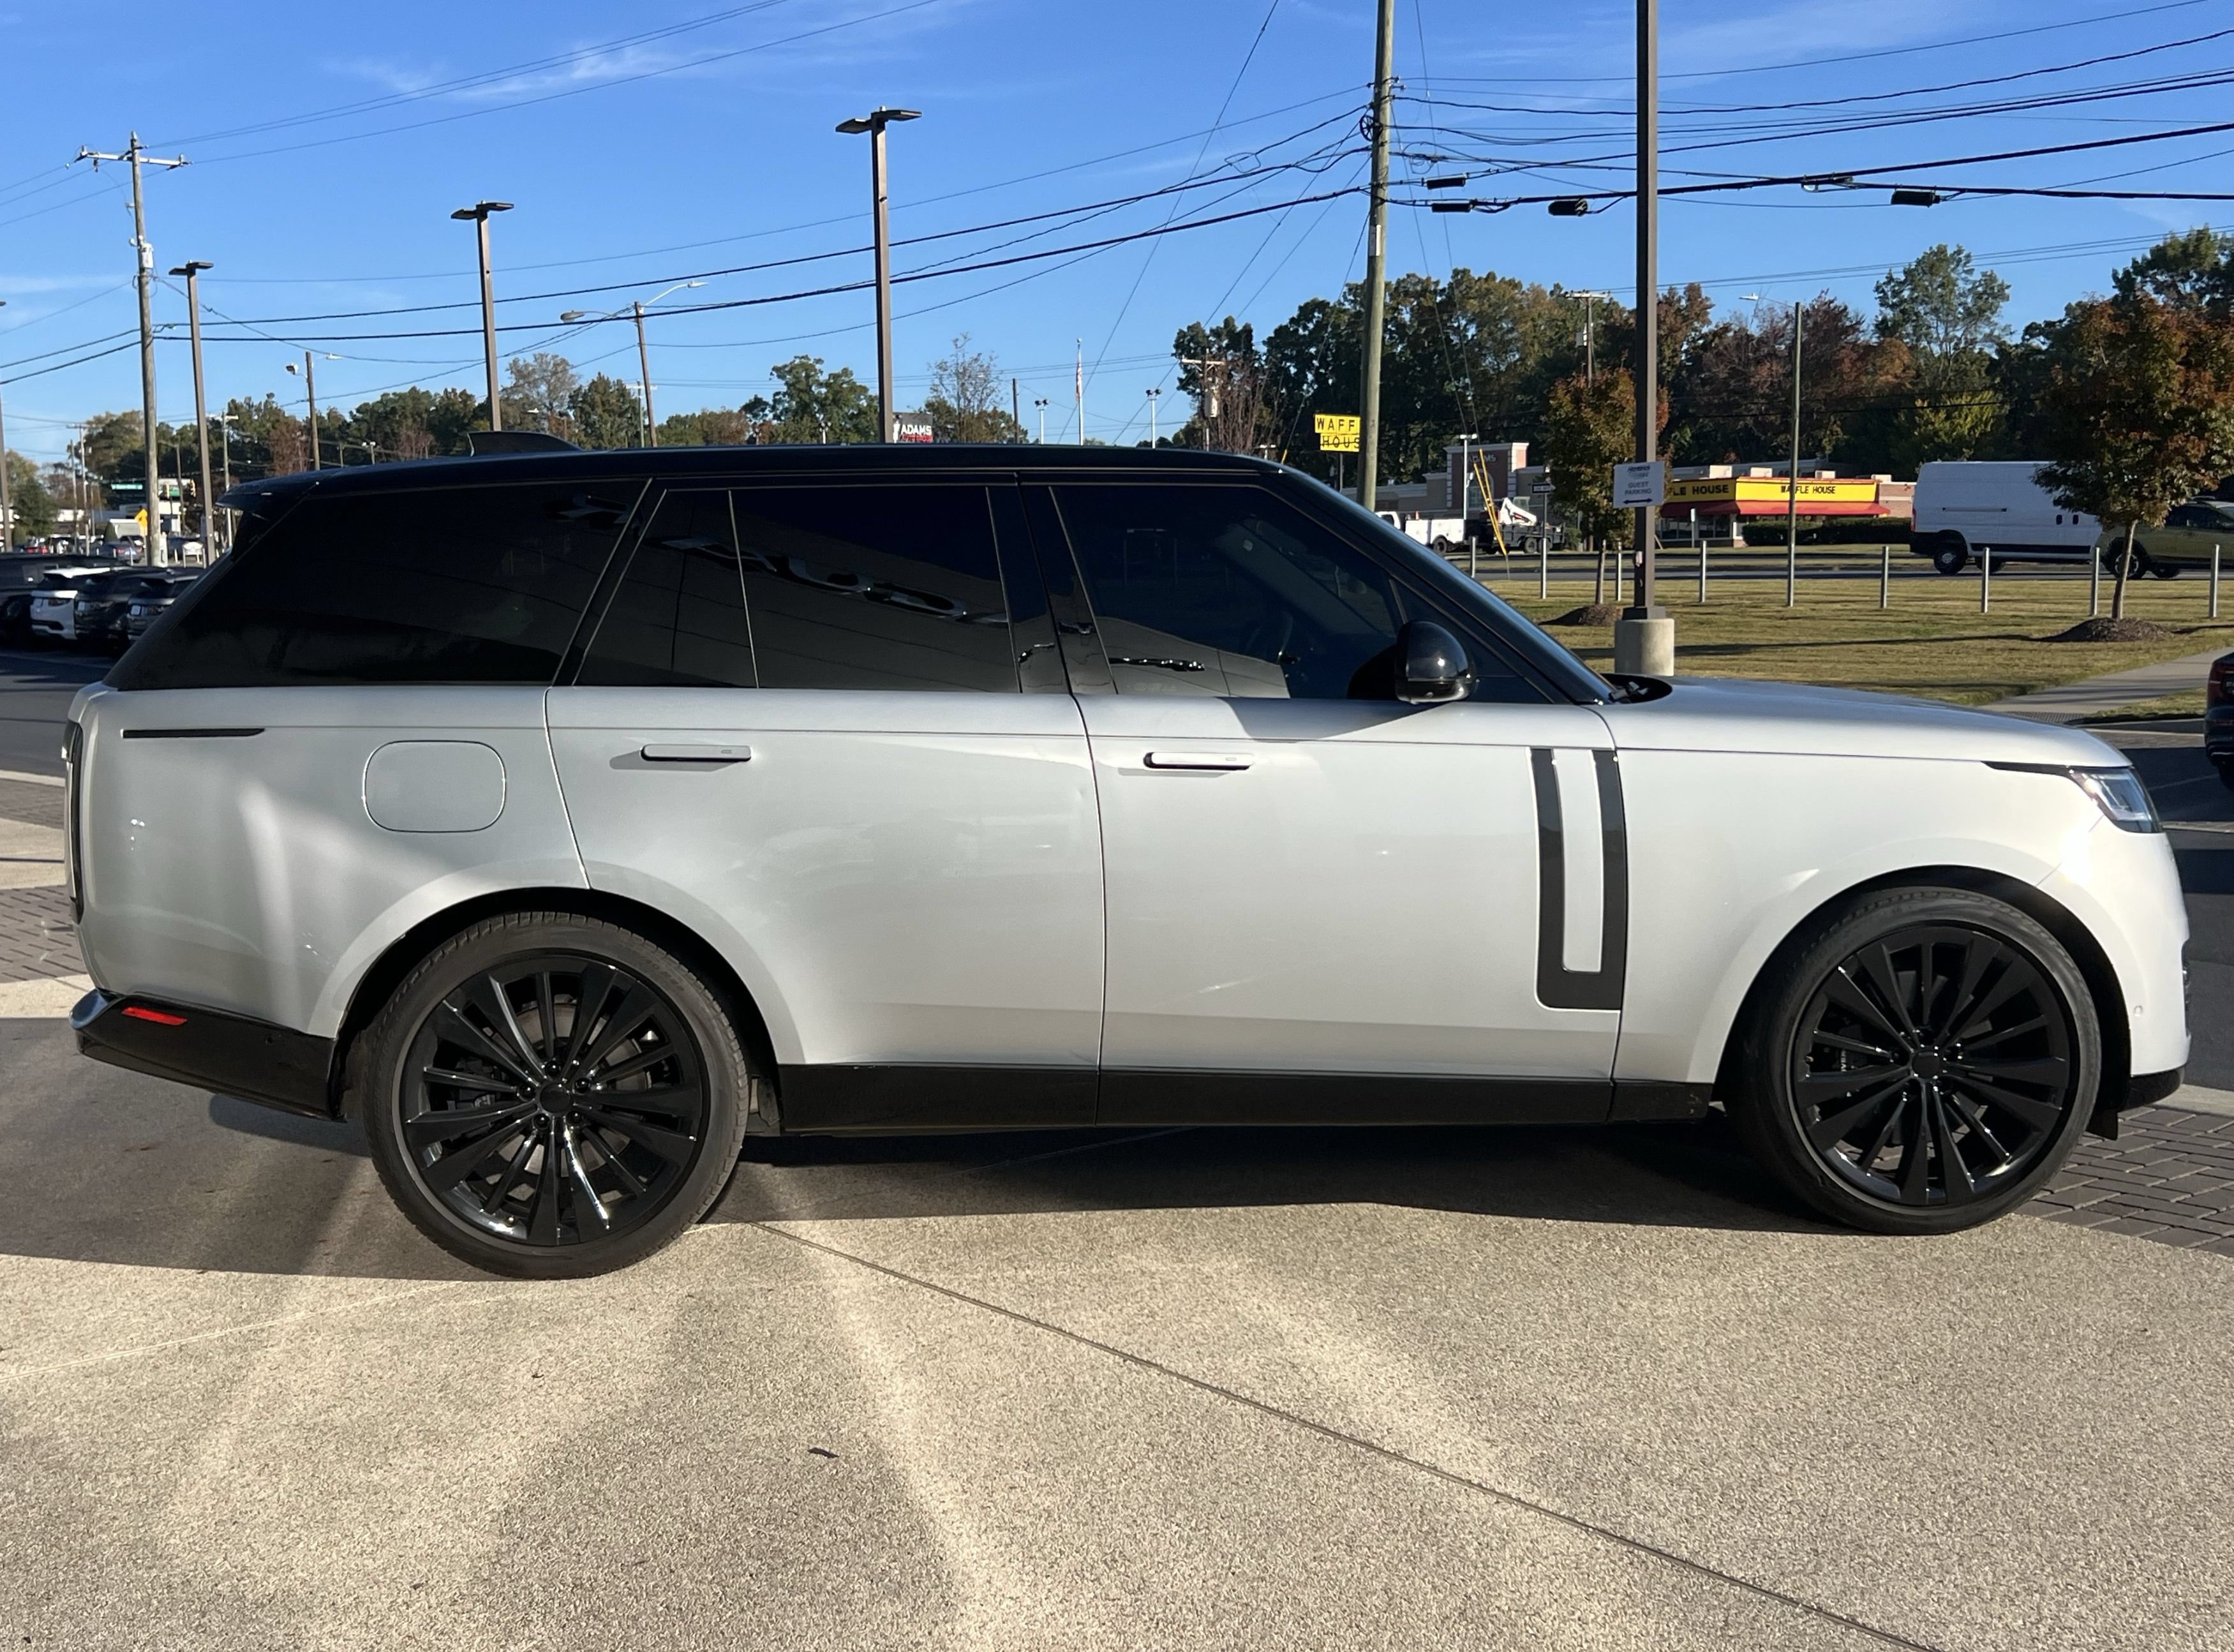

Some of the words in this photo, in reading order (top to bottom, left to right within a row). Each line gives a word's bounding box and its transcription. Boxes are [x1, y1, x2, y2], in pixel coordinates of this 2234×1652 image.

[900, 424, 932, 436] ADAMS
[1692, 484, 1729, 495] HOUSE
[1781, 486, 1809, 494] WAFLE
